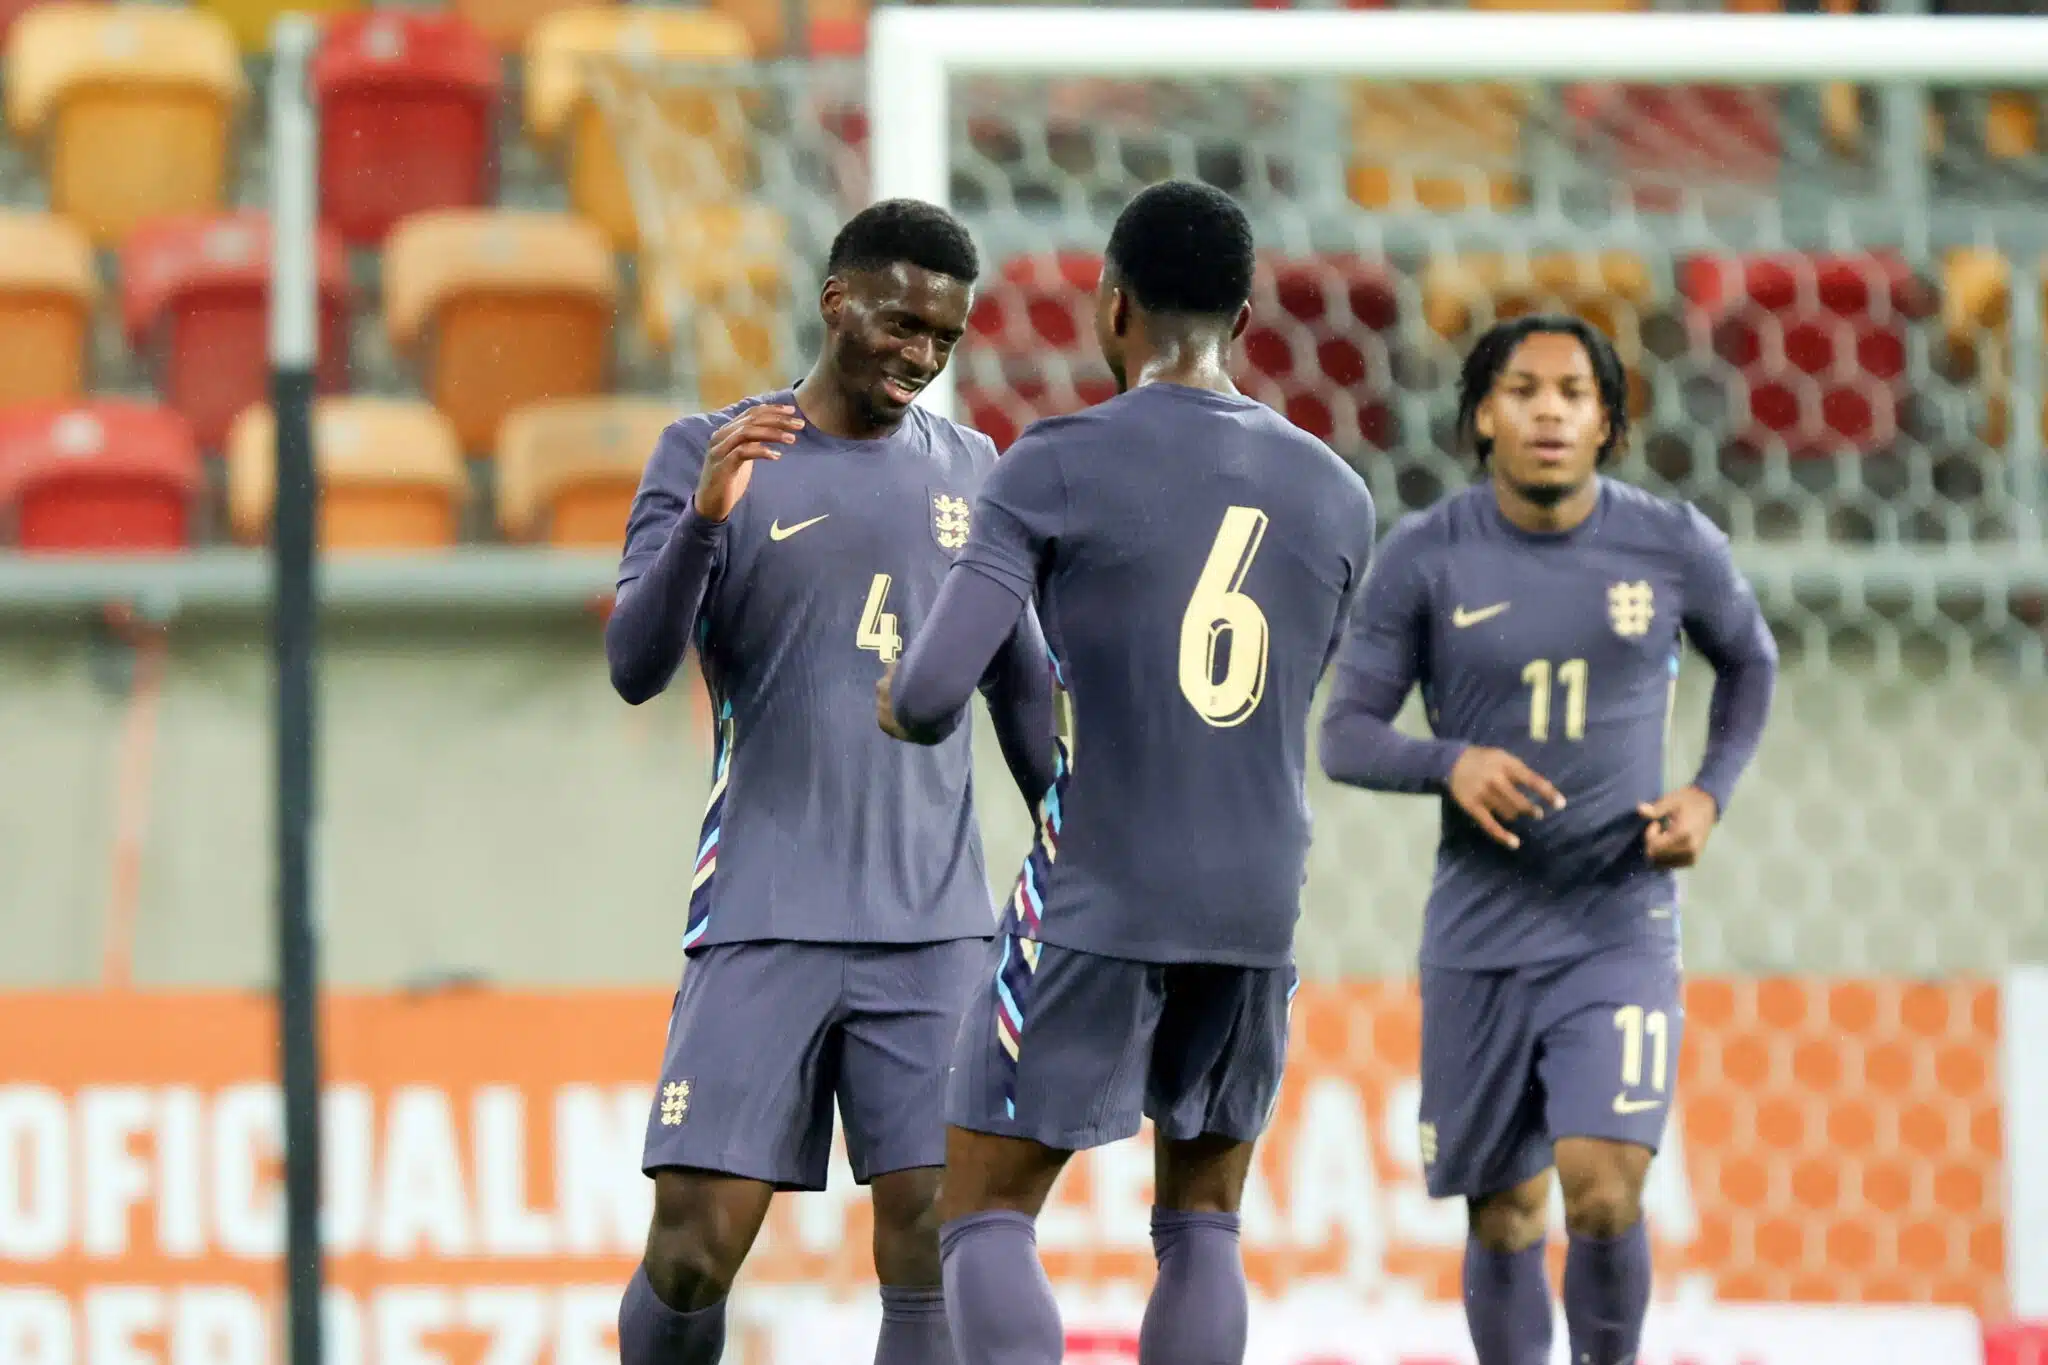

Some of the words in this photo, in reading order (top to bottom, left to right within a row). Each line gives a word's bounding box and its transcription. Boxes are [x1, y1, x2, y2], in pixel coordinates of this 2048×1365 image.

[856, 573, 902, 662] 4
[1179, 505, 1268, 727] 6
[1521, 658, 1587, 742] 11
[1613, 1004, 1667, 1092] 11
[0, 1083, 657, 1257] OFICJALN
